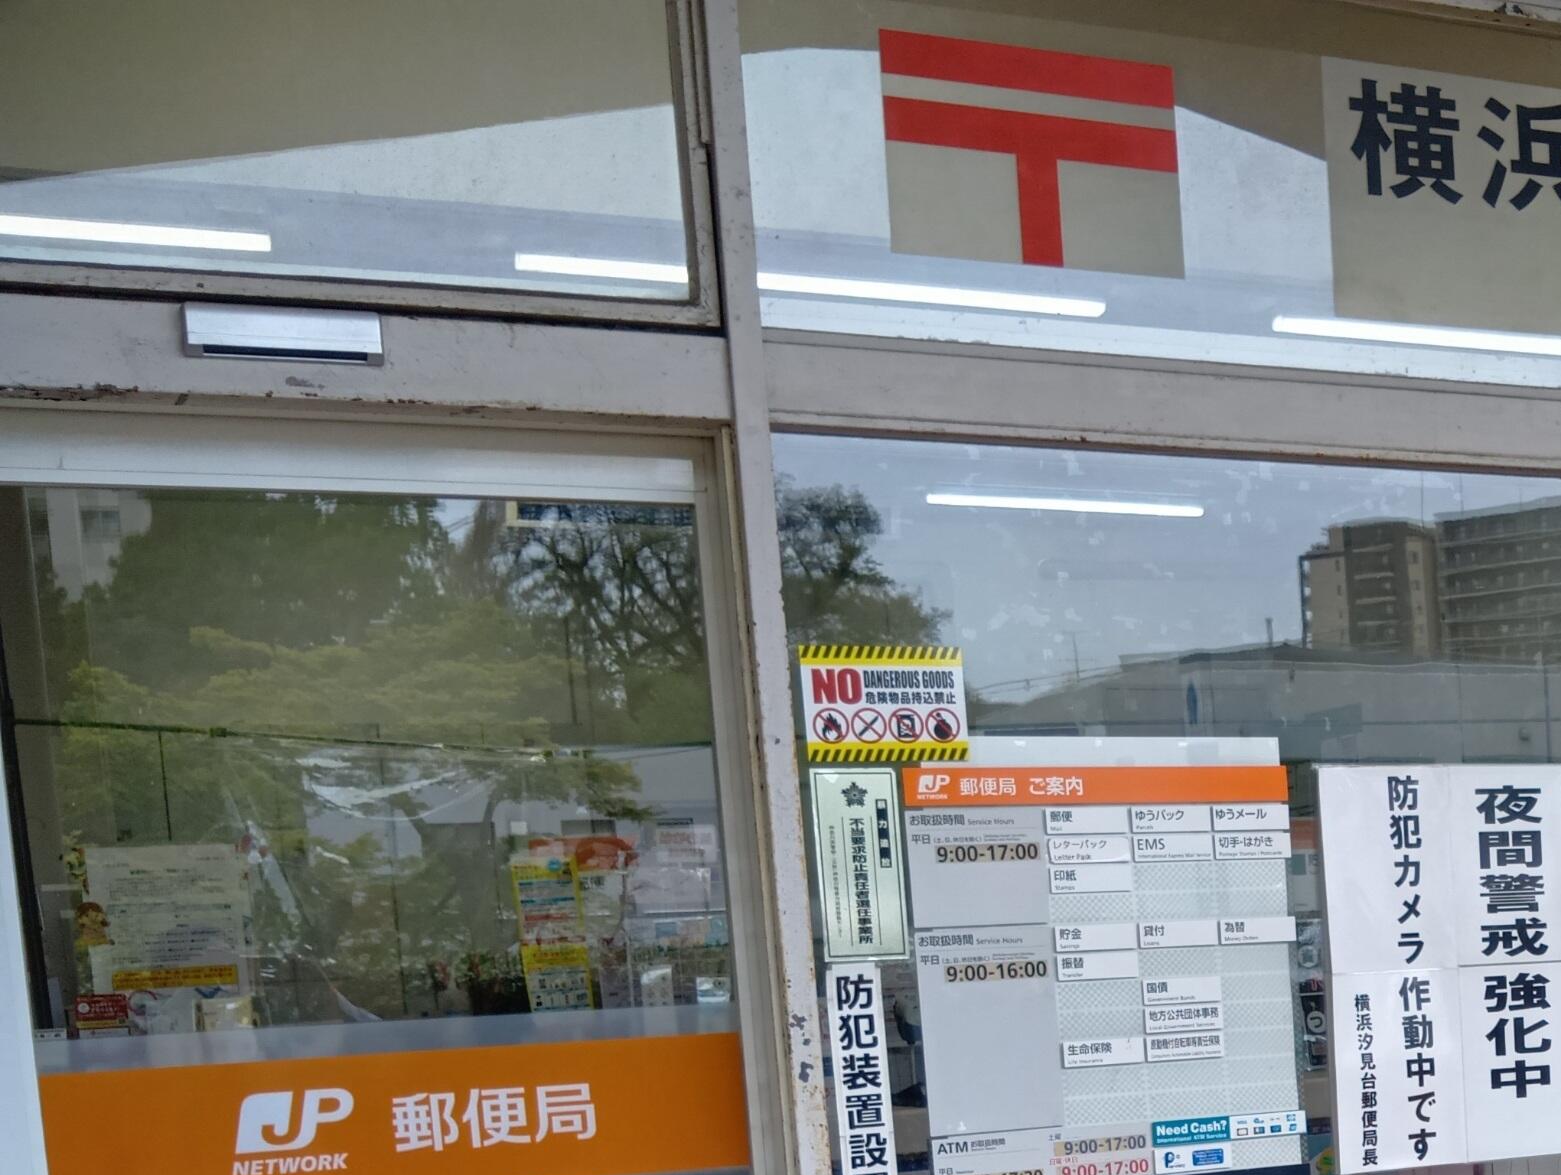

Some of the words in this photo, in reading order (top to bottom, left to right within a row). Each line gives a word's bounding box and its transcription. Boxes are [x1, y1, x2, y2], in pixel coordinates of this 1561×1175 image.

[811, 668, 864, 705] NO
[864, 671, 918, 690] DANGEROUS
[921, 670, 955, 690] GOODS
[865, 691, 957, 705] 危険物品持込禁止
[918, 775, 950, 794] JP
[960, 776, 1017, 798] 郵便局
[1029, 776, 1084, 798] ご案内
[909, 814, 966, 827] お取扱時間
[967, 818, 993, 826] Service
[1050, 810, 1073, 823] 郵便
[1135, 809, 1185, 822] ゆうパック
[1215, 808, 1268, 821] ゆうメール
[911, 833, 932, 845] 平日
[1053, 839, 1108, 850] レターパック
[1137, 838, 1166, 851] EMS
[936, 843, 1039, 864] 9:00-17:00
[1053, 869, 1078, 882] 印紙
[1059, 927, 1083, 941] 貯金
[1143, 925, 1166, 938] 貸付
[1224, 921, 1246, 934] 為替
[918, 934, 975, 947] お取扱時間
[1475, 784, 1552, 1100] 夜間警戒強化中
[920, 955, 940, 966] 平日
[1061, 956, 1085, 970] 振替
[946, 961, 1047, 983] 9:00-16:00
[1387, 774, 1438, 1162] 防犯カメラ作動中です
[1146, 981, 1169, 995] 国債
[1148, 1006, 1220, 1022] 地方公共団体事務
[1067, 1042, 1113, 1056] 生命保険
[1353, 993, 1379, 1168] 横浜汐見台郵便局長
[235, 1087, 354, 1155] JP
[391, 1083, 598, 1153] 郵便局
[1156, 1123, 1189, 1137] Need
[1190, 1119, 1228, 1134] Cash?
[937, 1140, 969, 1155] ATM
[1064, 1134, 1147, 1156] 9:00-17:00
